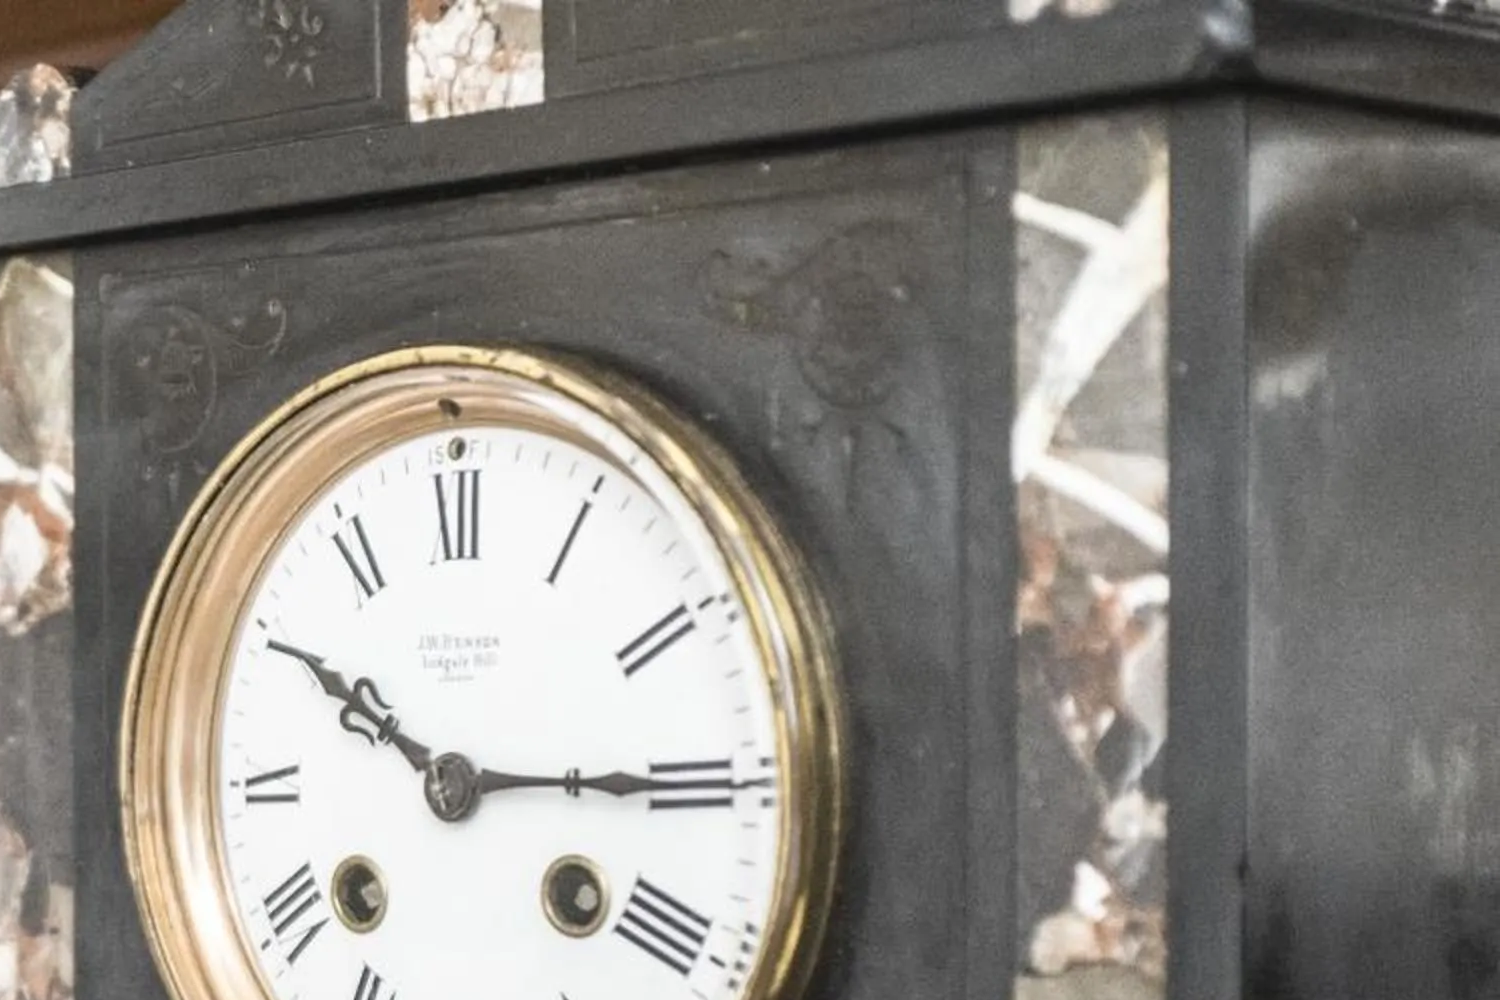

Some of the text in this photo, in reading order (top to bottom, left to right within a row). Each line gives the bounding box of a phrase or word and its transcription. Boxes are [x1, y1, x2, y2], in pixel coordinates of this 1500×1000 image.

[332, 513, 386, 610] XI
[430, 468, 481, 565] XII
[543, 498, 592, 586] I
[616, 601, 696, 678] II
[245, 756, 301, 809] IX
[648, 758, 734, 811] III
[262, 861, 330, 966] VIII
[611, 871, 712, 977] IIII
